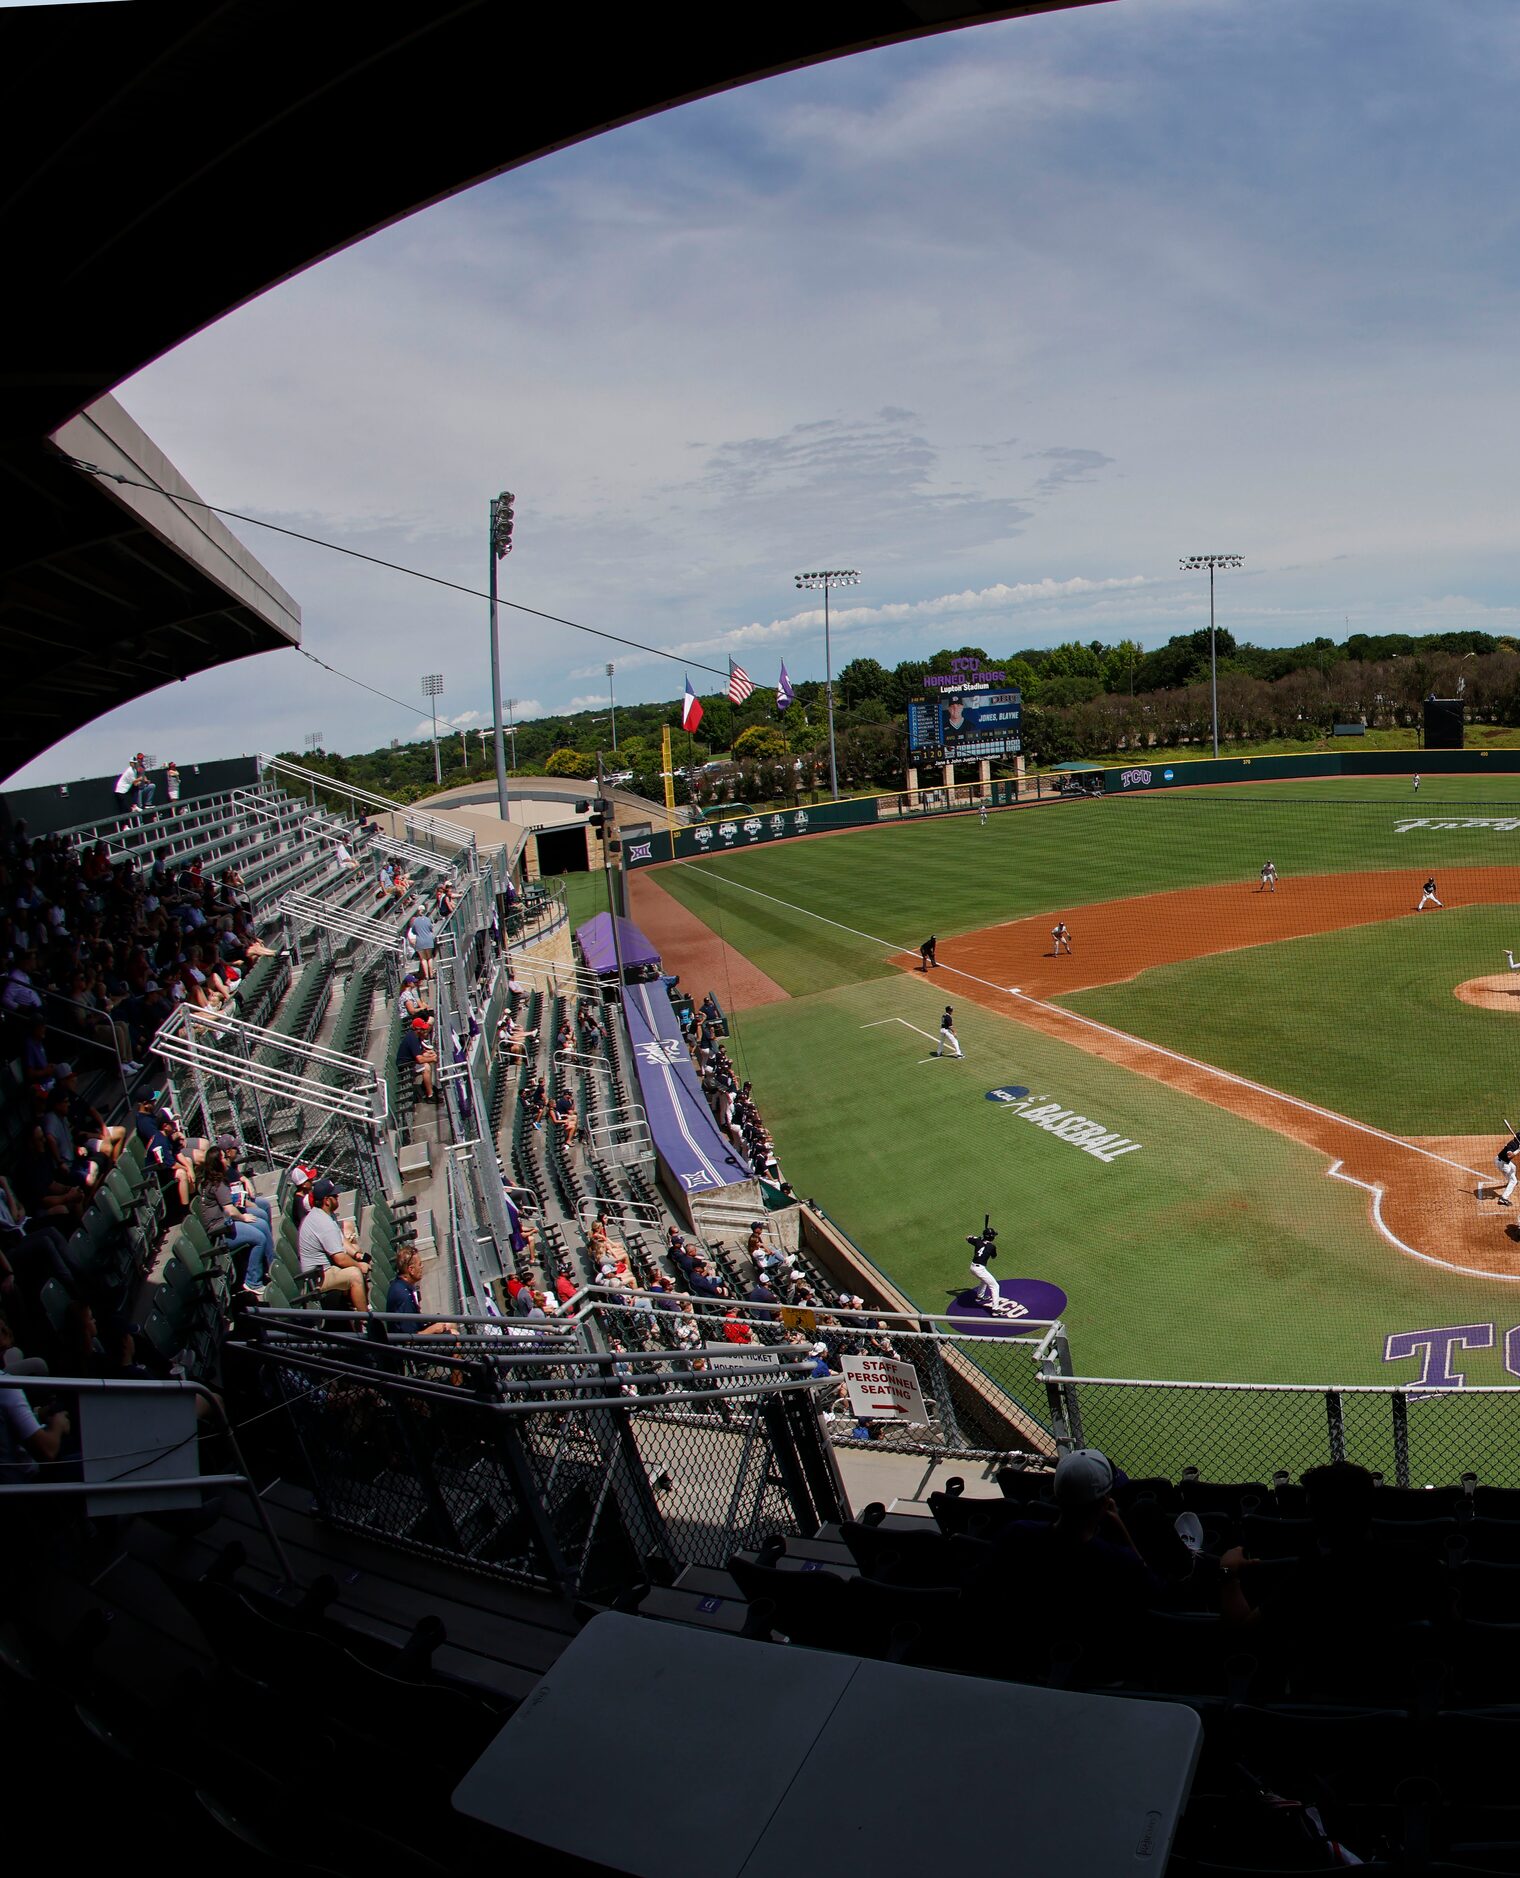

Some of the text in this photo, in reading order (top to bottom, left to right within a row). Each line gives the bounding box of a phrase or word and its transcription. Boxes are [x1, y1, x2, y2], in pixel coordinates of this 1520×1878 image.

[951, 657, 980, 672] TCU
[923, 671, 1006, 687] HORNED FROGS
[940, 682, 989, 694] Lupton Stadium
[1121, 769, 1152, 788] TCU
[990, 1089, 1143, 1163] NCAA BASEBALL
[977, 1246, 985, 1257] 4
[862, 1361, 898, 1374] STAFF
[846, 1371, 917, 1391] PERSONNEL
[860, 1384, 912, 1400] SEATING
